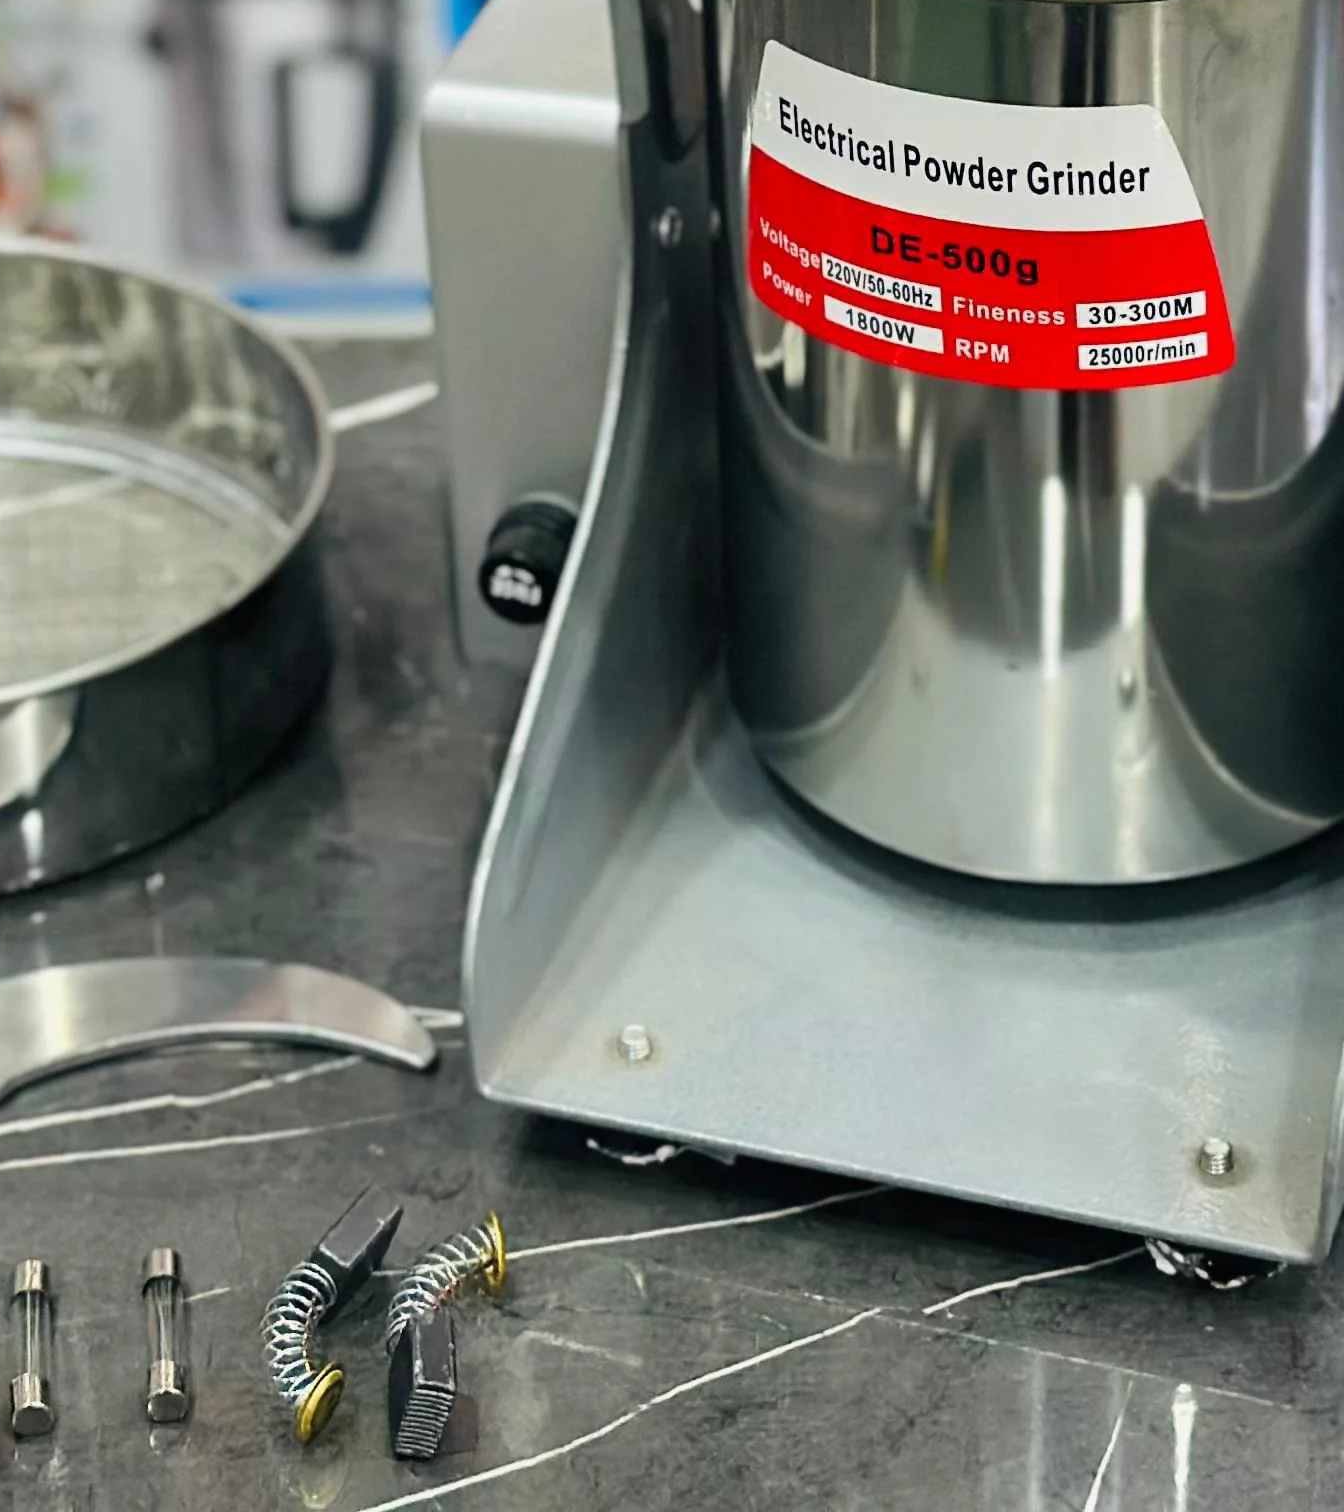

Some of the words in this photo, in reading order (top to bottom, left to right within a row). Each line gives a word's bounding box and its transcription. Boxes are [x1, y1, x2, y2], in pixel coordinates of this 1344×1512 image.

[779, 96, 896, 174] Electrical
[903, 143, 1018, 193] Powder
[1027, 161, 1150, 196] Grinder
[759, 216, 821, 269] Voltage
[825, 258, 934, 308] 220V/50-60Hz
[952, 295, 1066, 326] Fineness
[1088, 296, 1193, 325] 30-300M
[871, 225, 1039, 286] DE-500g
[762, 261, 813, 308] Power
[845, 308, 915, 345] 1800W
[955, 337, 1010, 364] RPM
[1088, 341, 1196, 366] 25000r/min
